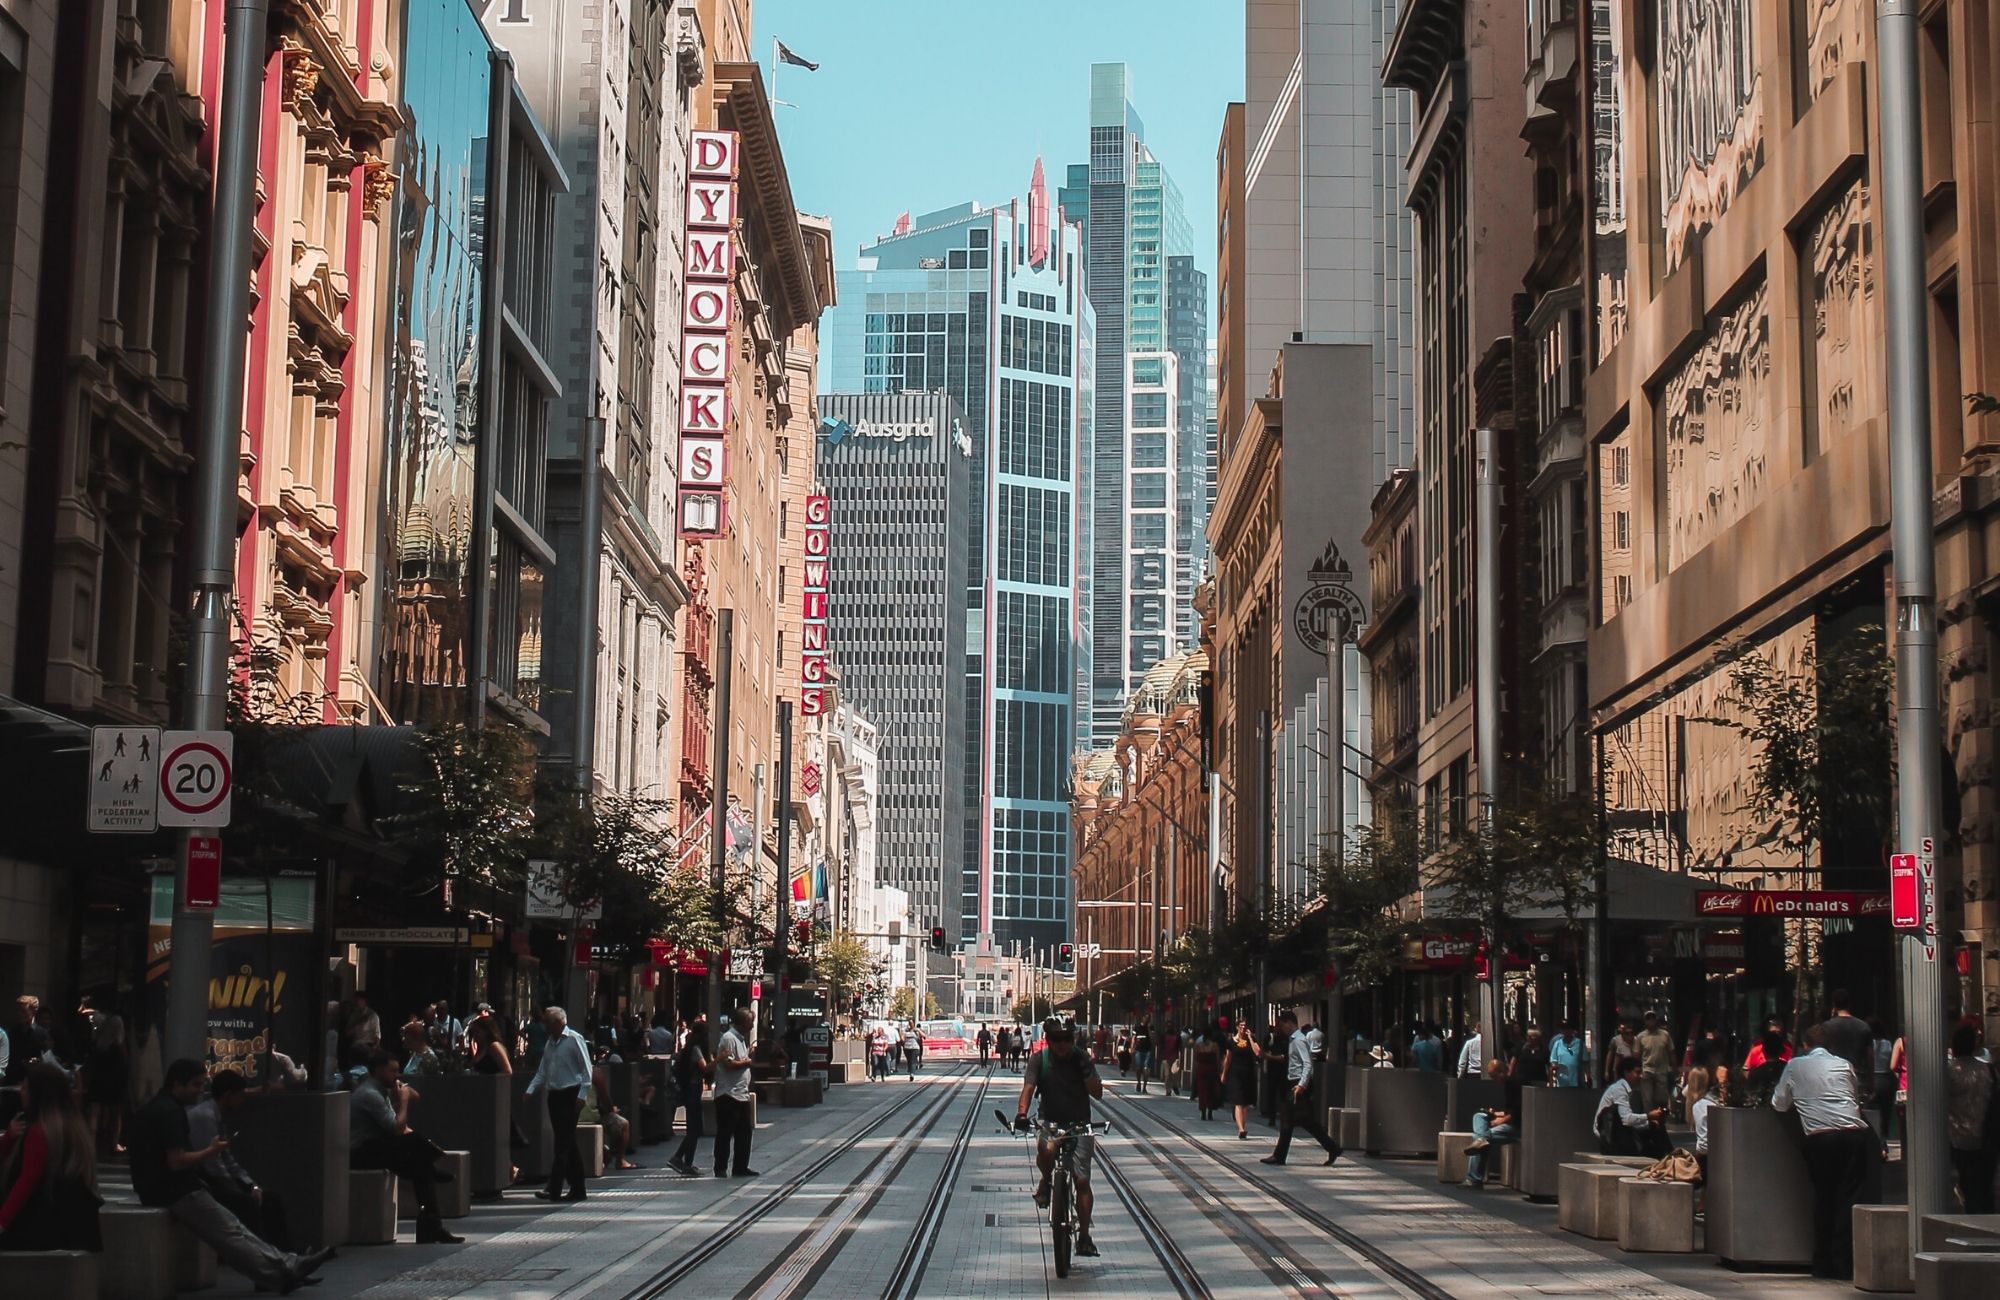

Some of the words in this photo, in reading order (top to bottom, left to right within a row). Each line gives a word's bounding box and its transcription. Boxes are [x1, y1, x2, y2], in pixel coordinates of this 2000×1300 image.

[687, 138, 728, 481] DYMOCKS
[854, 417, 935, 442] Ausgrid
[803, 500, 826, 714] GOWINGS
[1307, 587, 1353, 605] HEALTH
[1298, 619, 1321, 650] CARE
[175, 763, 216, 794] 20
[98, 808, 150, 816] PEDESTRIAN
[104, 817, 143, 825] ACTIVITY
[191, 851, 217, 859] STOPPING
[842, 849, 850, 928] GALERIES
[224, 1018, 246, 1028] with
[248, 1020, 255, 1028] a
